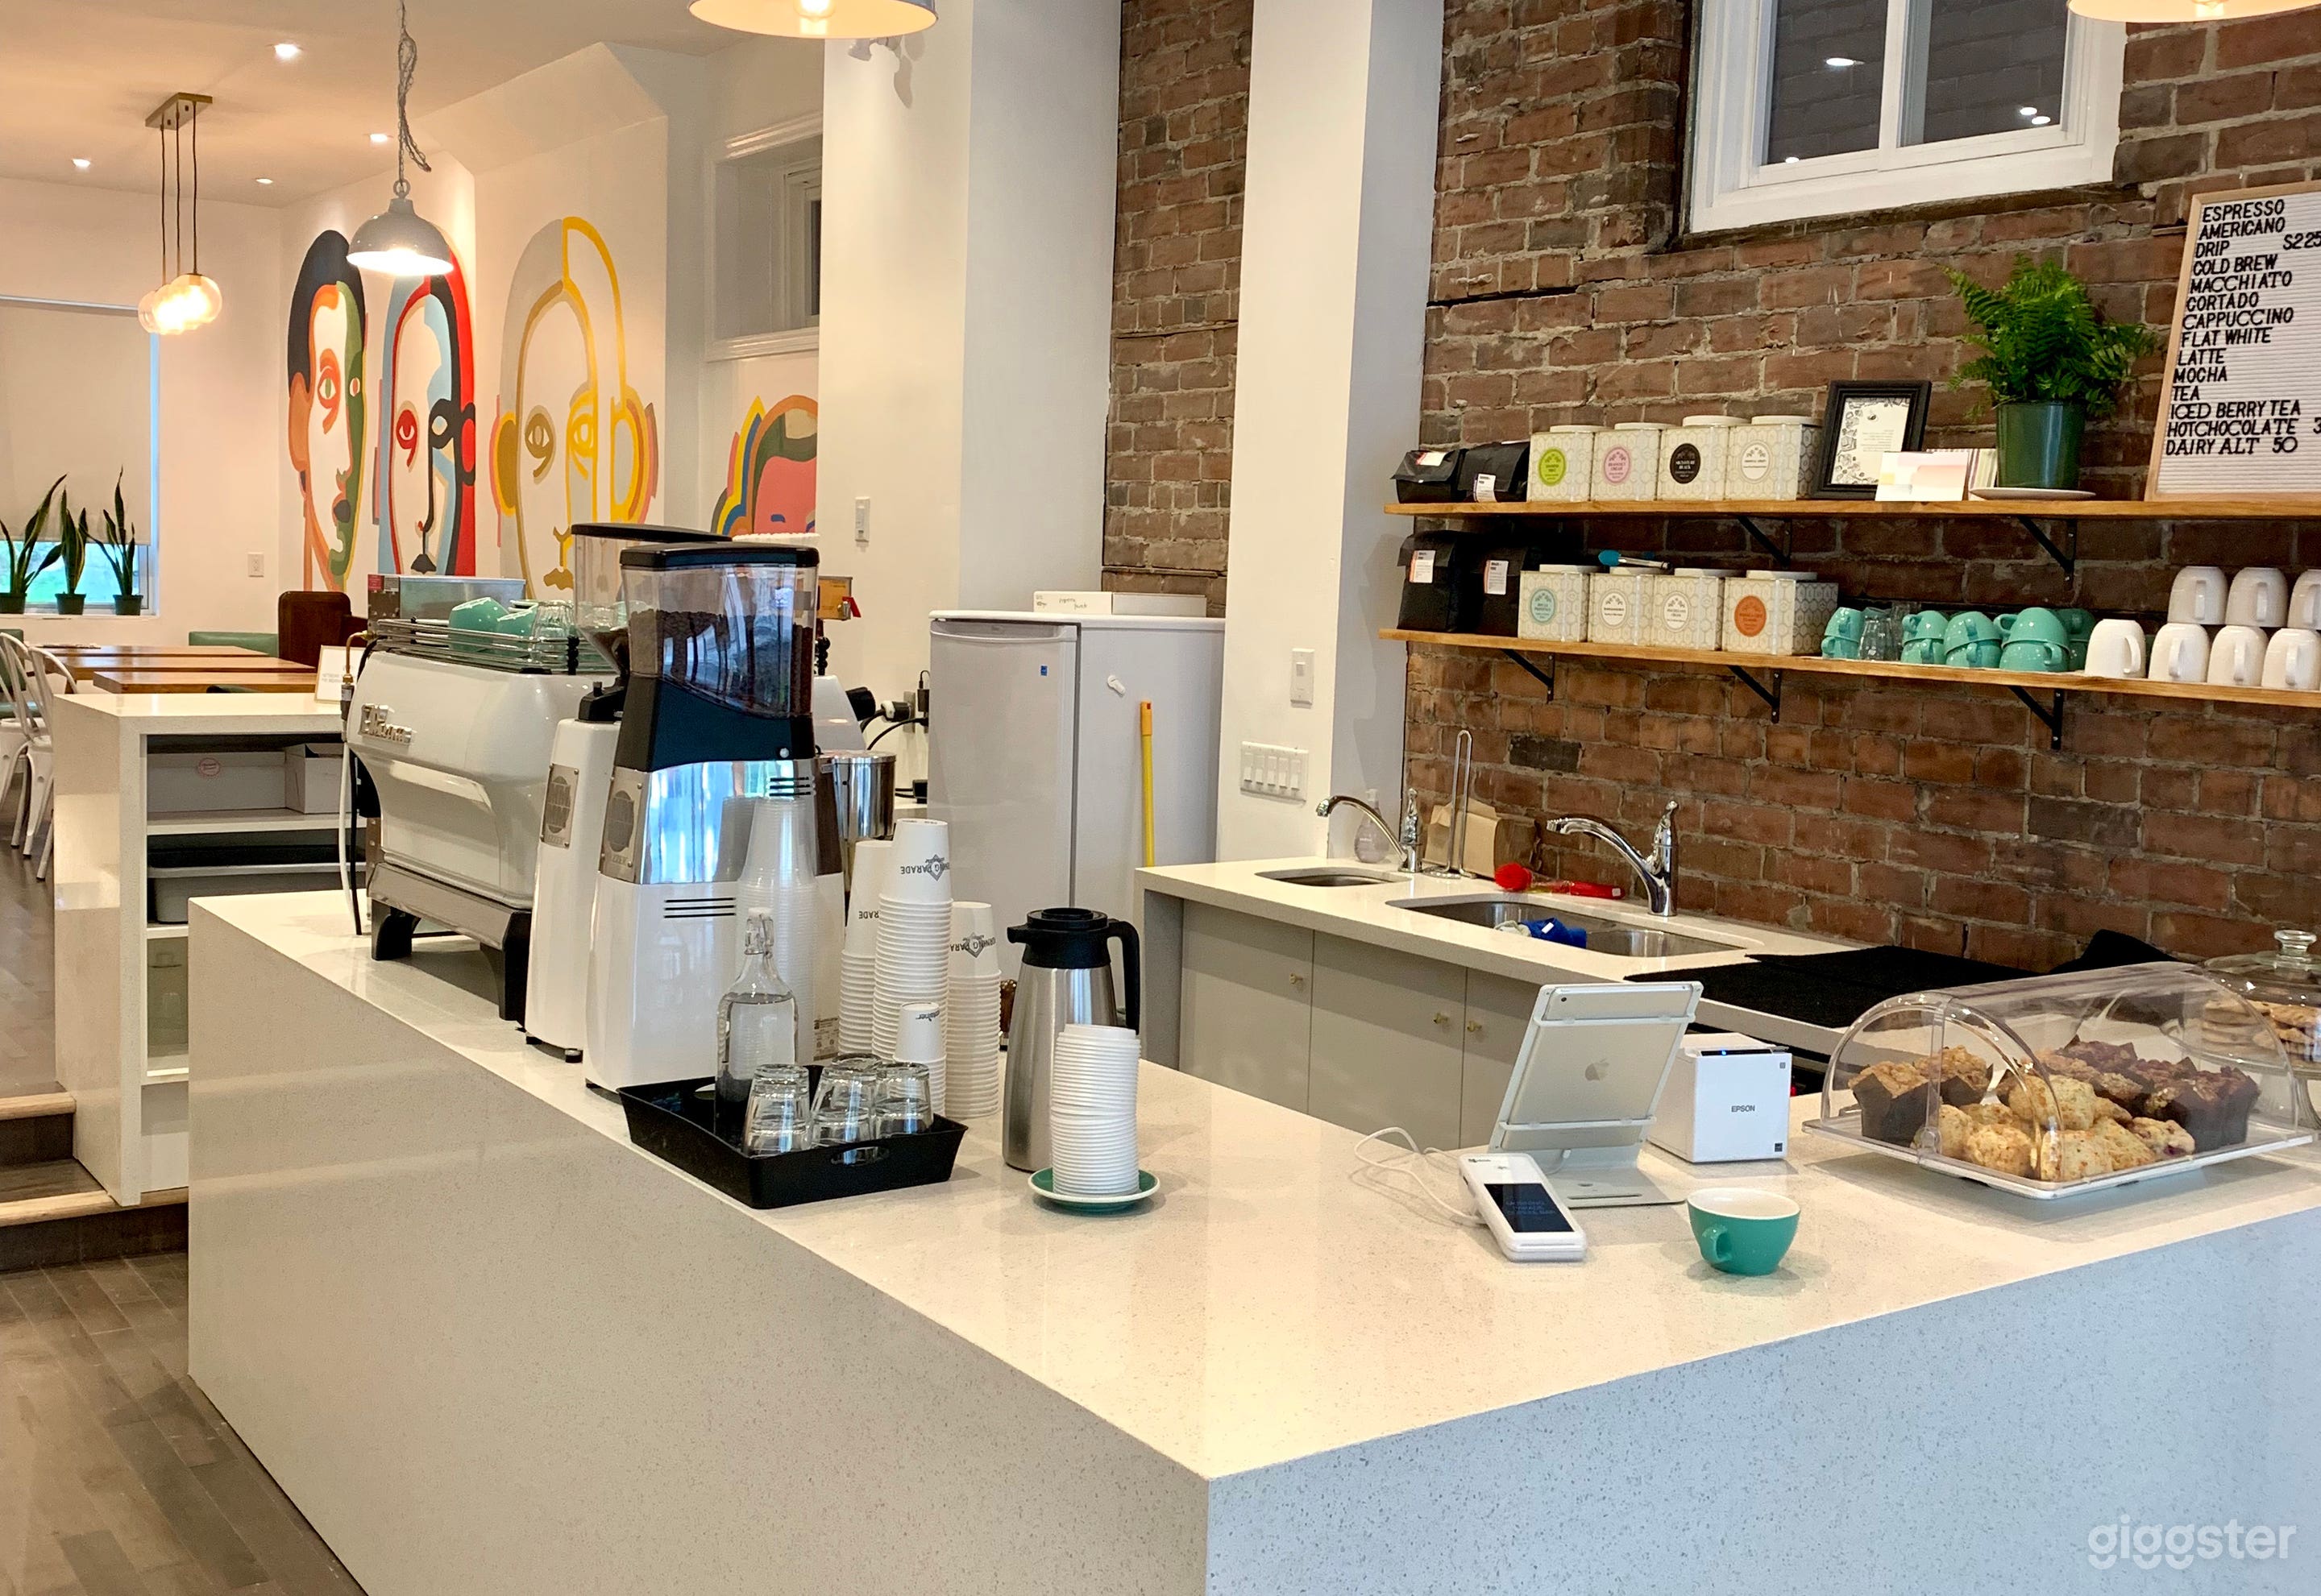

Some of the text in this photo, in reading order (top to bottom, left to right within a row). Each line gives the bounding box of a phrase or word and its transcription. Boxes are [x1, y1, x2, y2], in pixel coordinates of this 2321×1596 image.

[2202, 199, 2285, 222] ESPRESSO
[2199, 217, 2286, 241] AMERICANO
[2194, 240, 2230, 259] DRIP
[2193, 254, 2278, 276] COLD BREW
[2190, 270, 2293, 294] MACCHIATO
[2186, 291, 2260, 312] CORTADO
[2182, 307, 2294, 330] CAPPUCCINO
[2181, 326, 2273, 347] FLAT WHITE
[2178, 347, 2227, 366] LATTE
[2173, 366, 2228, 383] MOCHA
[2172, 385, 2200, 401] TEA
[2170, 400, 2301, 420] ICED BERRY TEA
[2165, 438, 2215, 455] DAIRY
[2218, 437, 2260, 454] ALT
[900, 864, 932, 874] PARADE
[1731, 1105, 1755, 1113] EPSON
